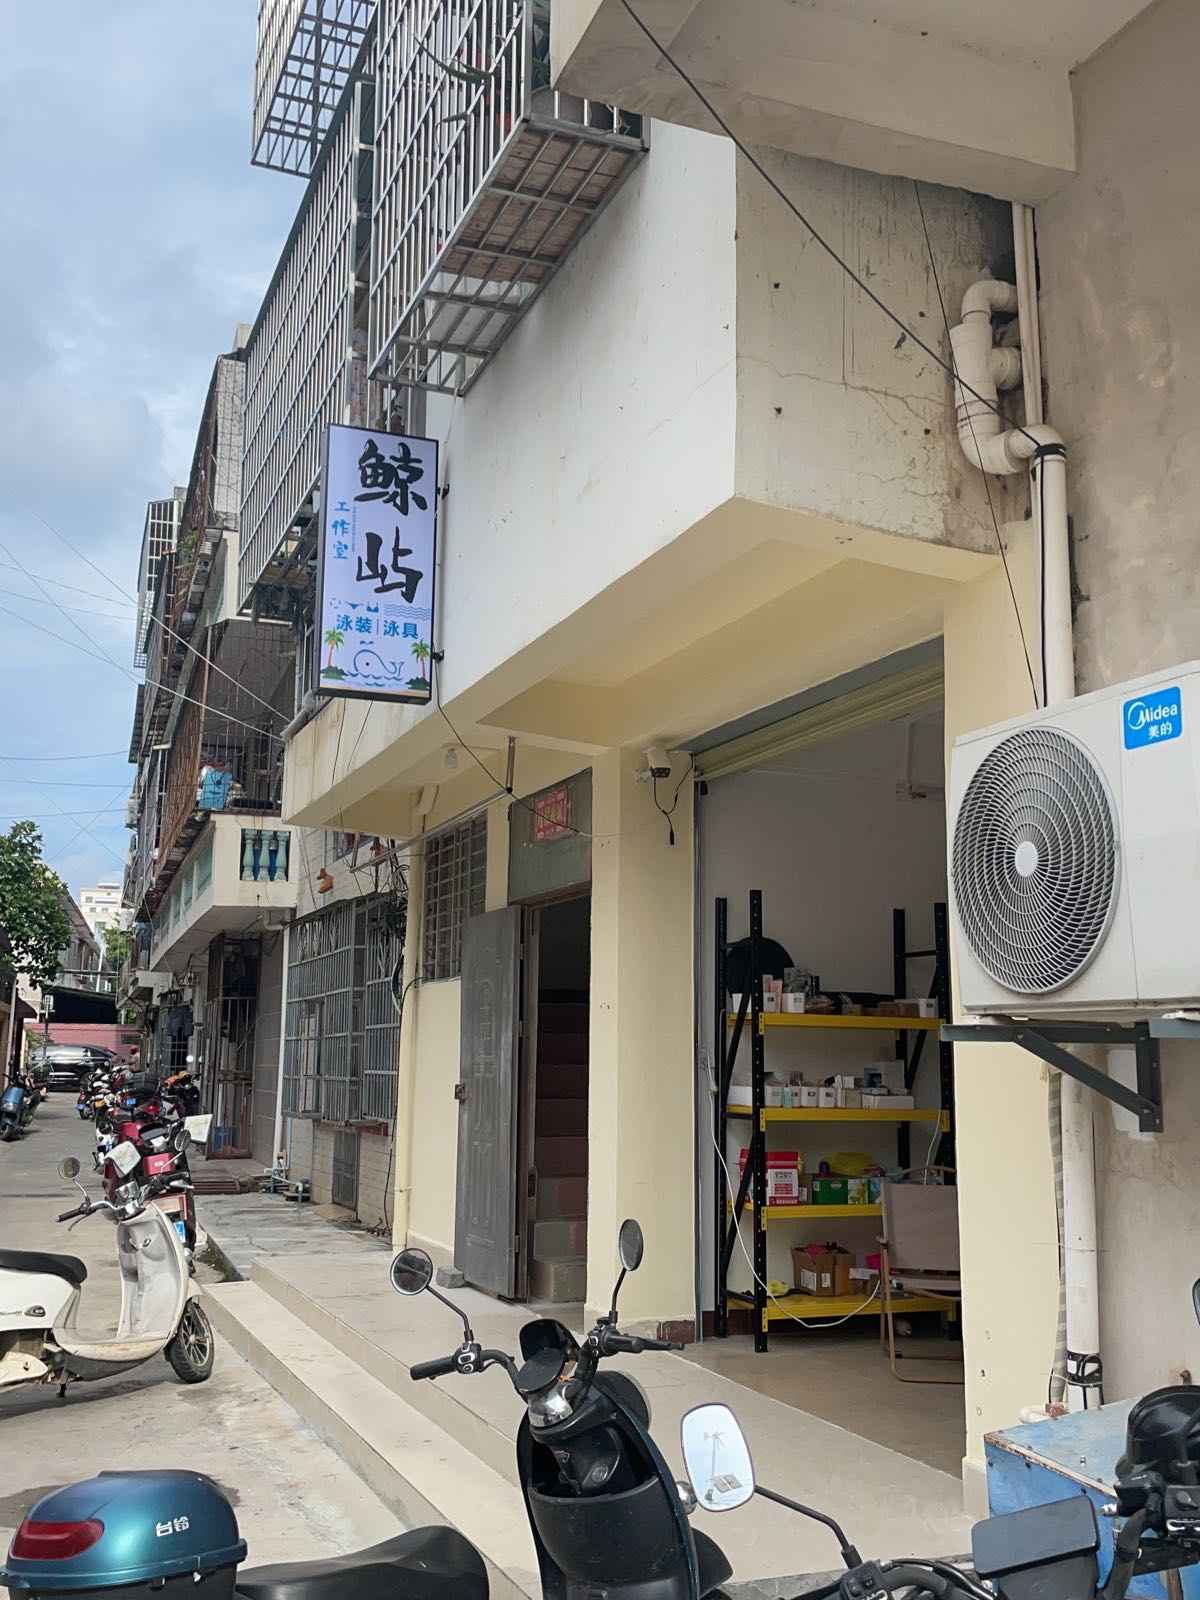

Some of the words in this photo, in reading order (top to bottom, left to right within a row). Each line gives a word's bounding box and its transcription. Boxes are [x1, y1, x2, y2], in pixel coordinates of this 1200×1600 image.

[332, 501, 350, 559] 工作室
[354, 438, 427, 603] 鲸屿
[336, 614, 372, 634] 泳装
[383, 620, 418, 639] 泳具
[1130, 702, 1178, 728] Midea
[1148, 721, 1172, 740] 美的
[156, 1516, 190, 1537] 台铃
